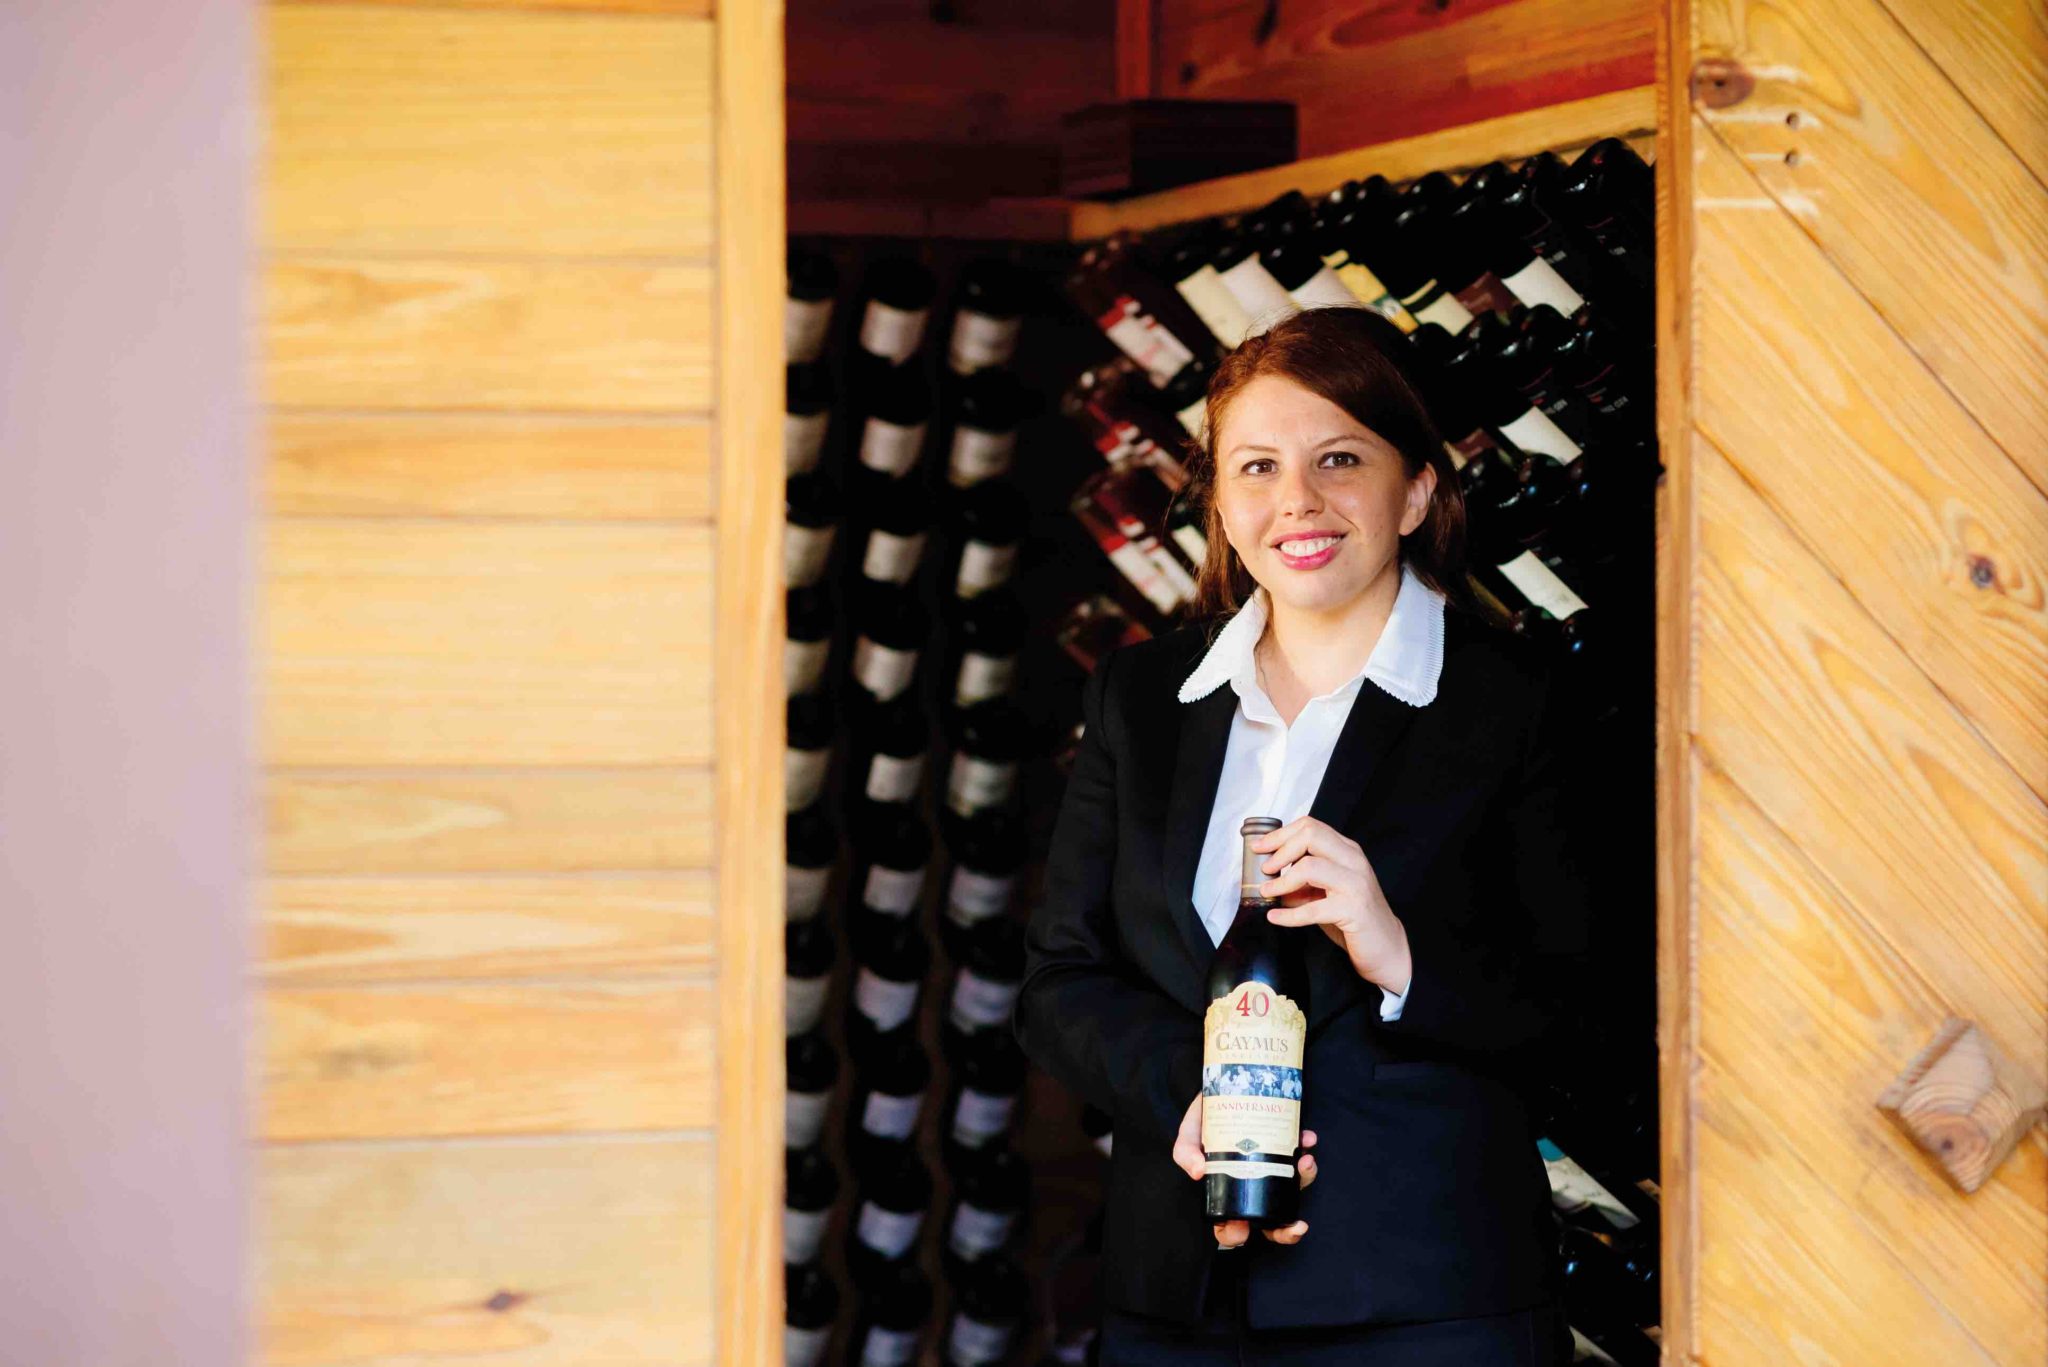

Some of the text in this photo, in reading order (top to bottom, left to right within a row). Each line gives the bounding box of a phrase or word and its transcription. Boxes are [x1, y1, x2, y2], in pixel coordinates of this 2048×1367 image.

[1236, 990, 1270, 1018] 40
[1215, 1031, 1289, 1053] CAYMUS
[1216, 1102, 1284, 1114] ANNIVERSARY
